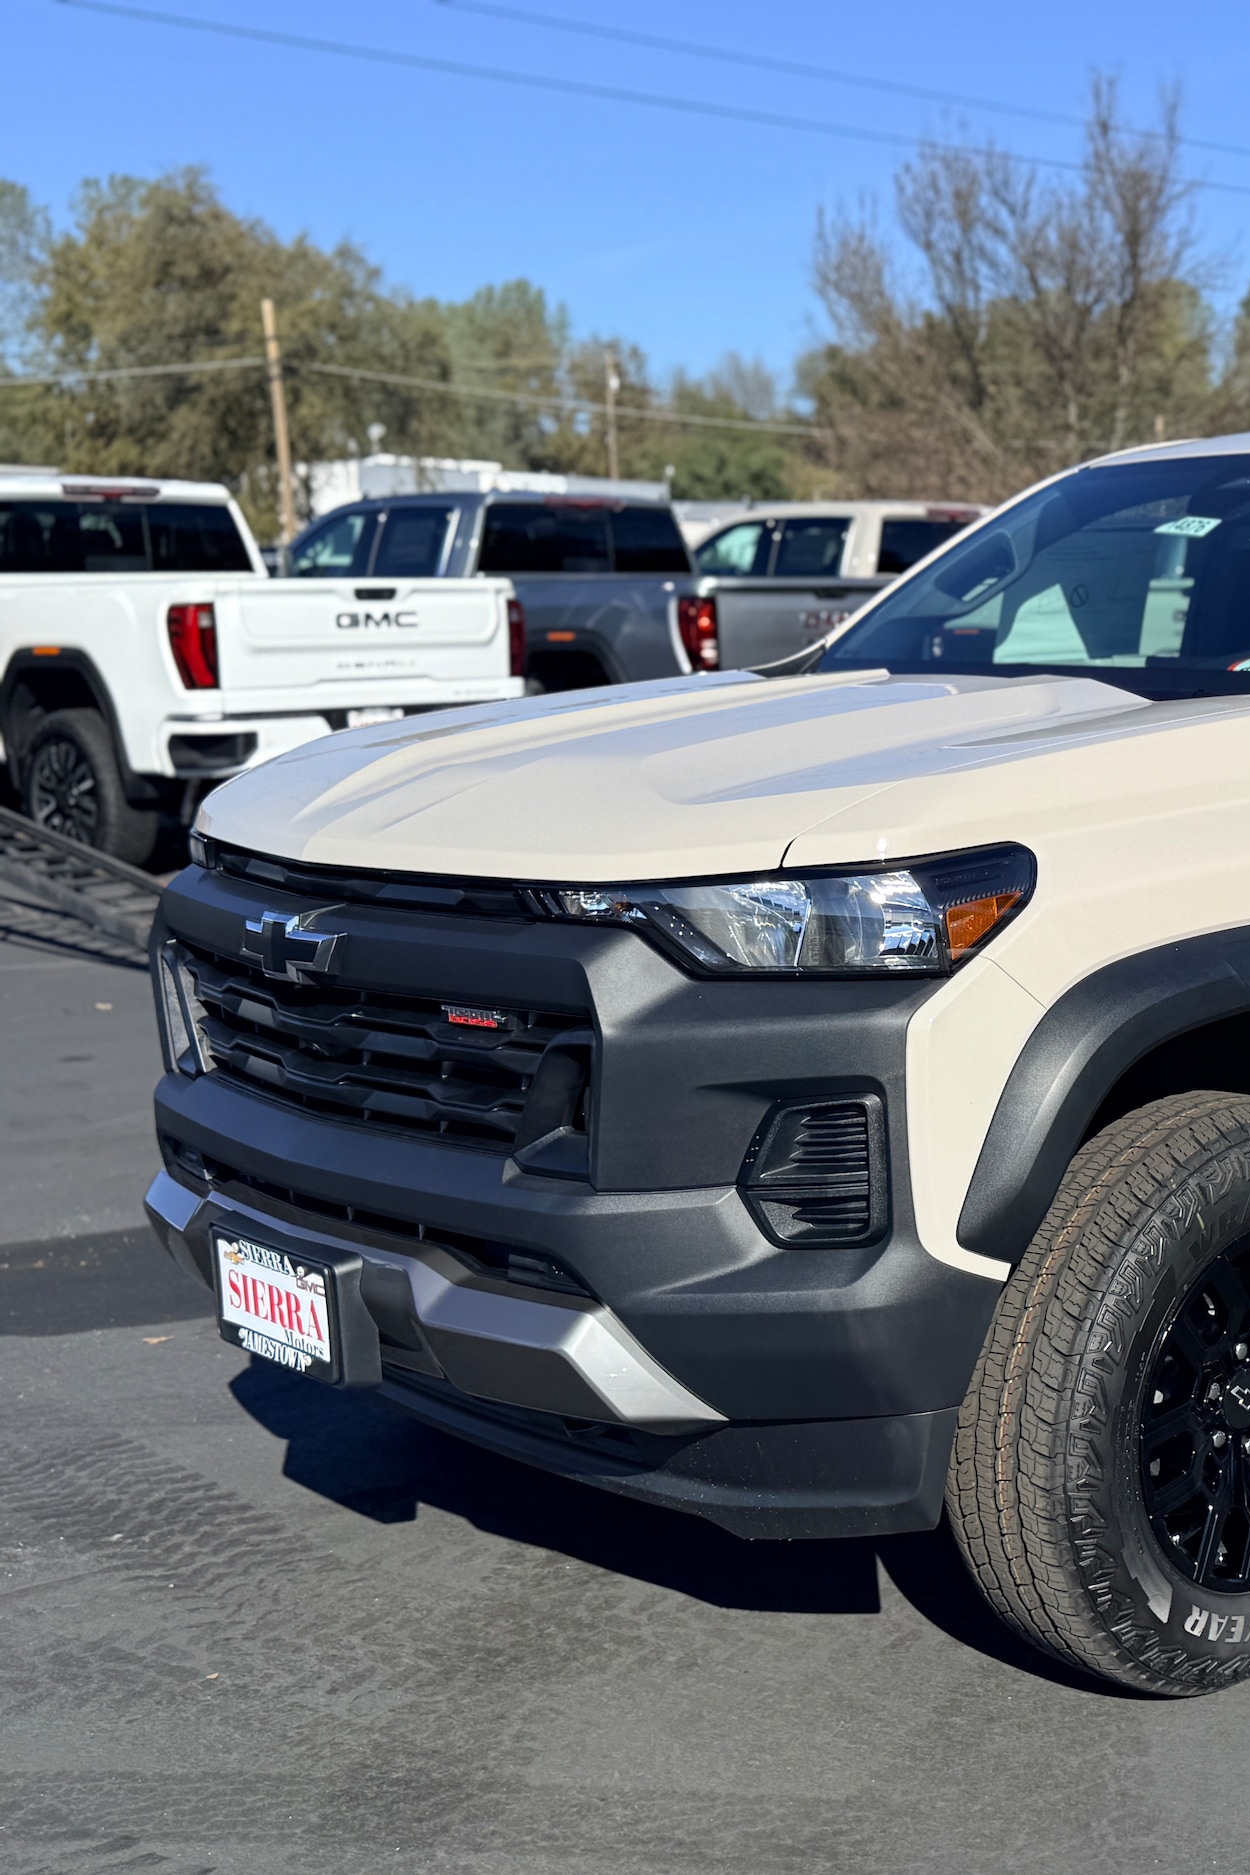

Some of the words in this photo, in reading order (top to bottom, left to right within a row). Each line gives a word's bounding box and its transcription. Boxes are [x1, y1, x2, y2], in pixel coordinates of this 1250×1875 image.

[336, 612, 417, 628] GMC
[238, 1239, 299, 1277] SIERRA
[296, 1277, 325, 1296] GMC
[228, 1269, 326, 1343] SIERRA
[241, 1327, 308, 1373] JAMESTOWN
[284, 1329, 325, 1358] Motors
